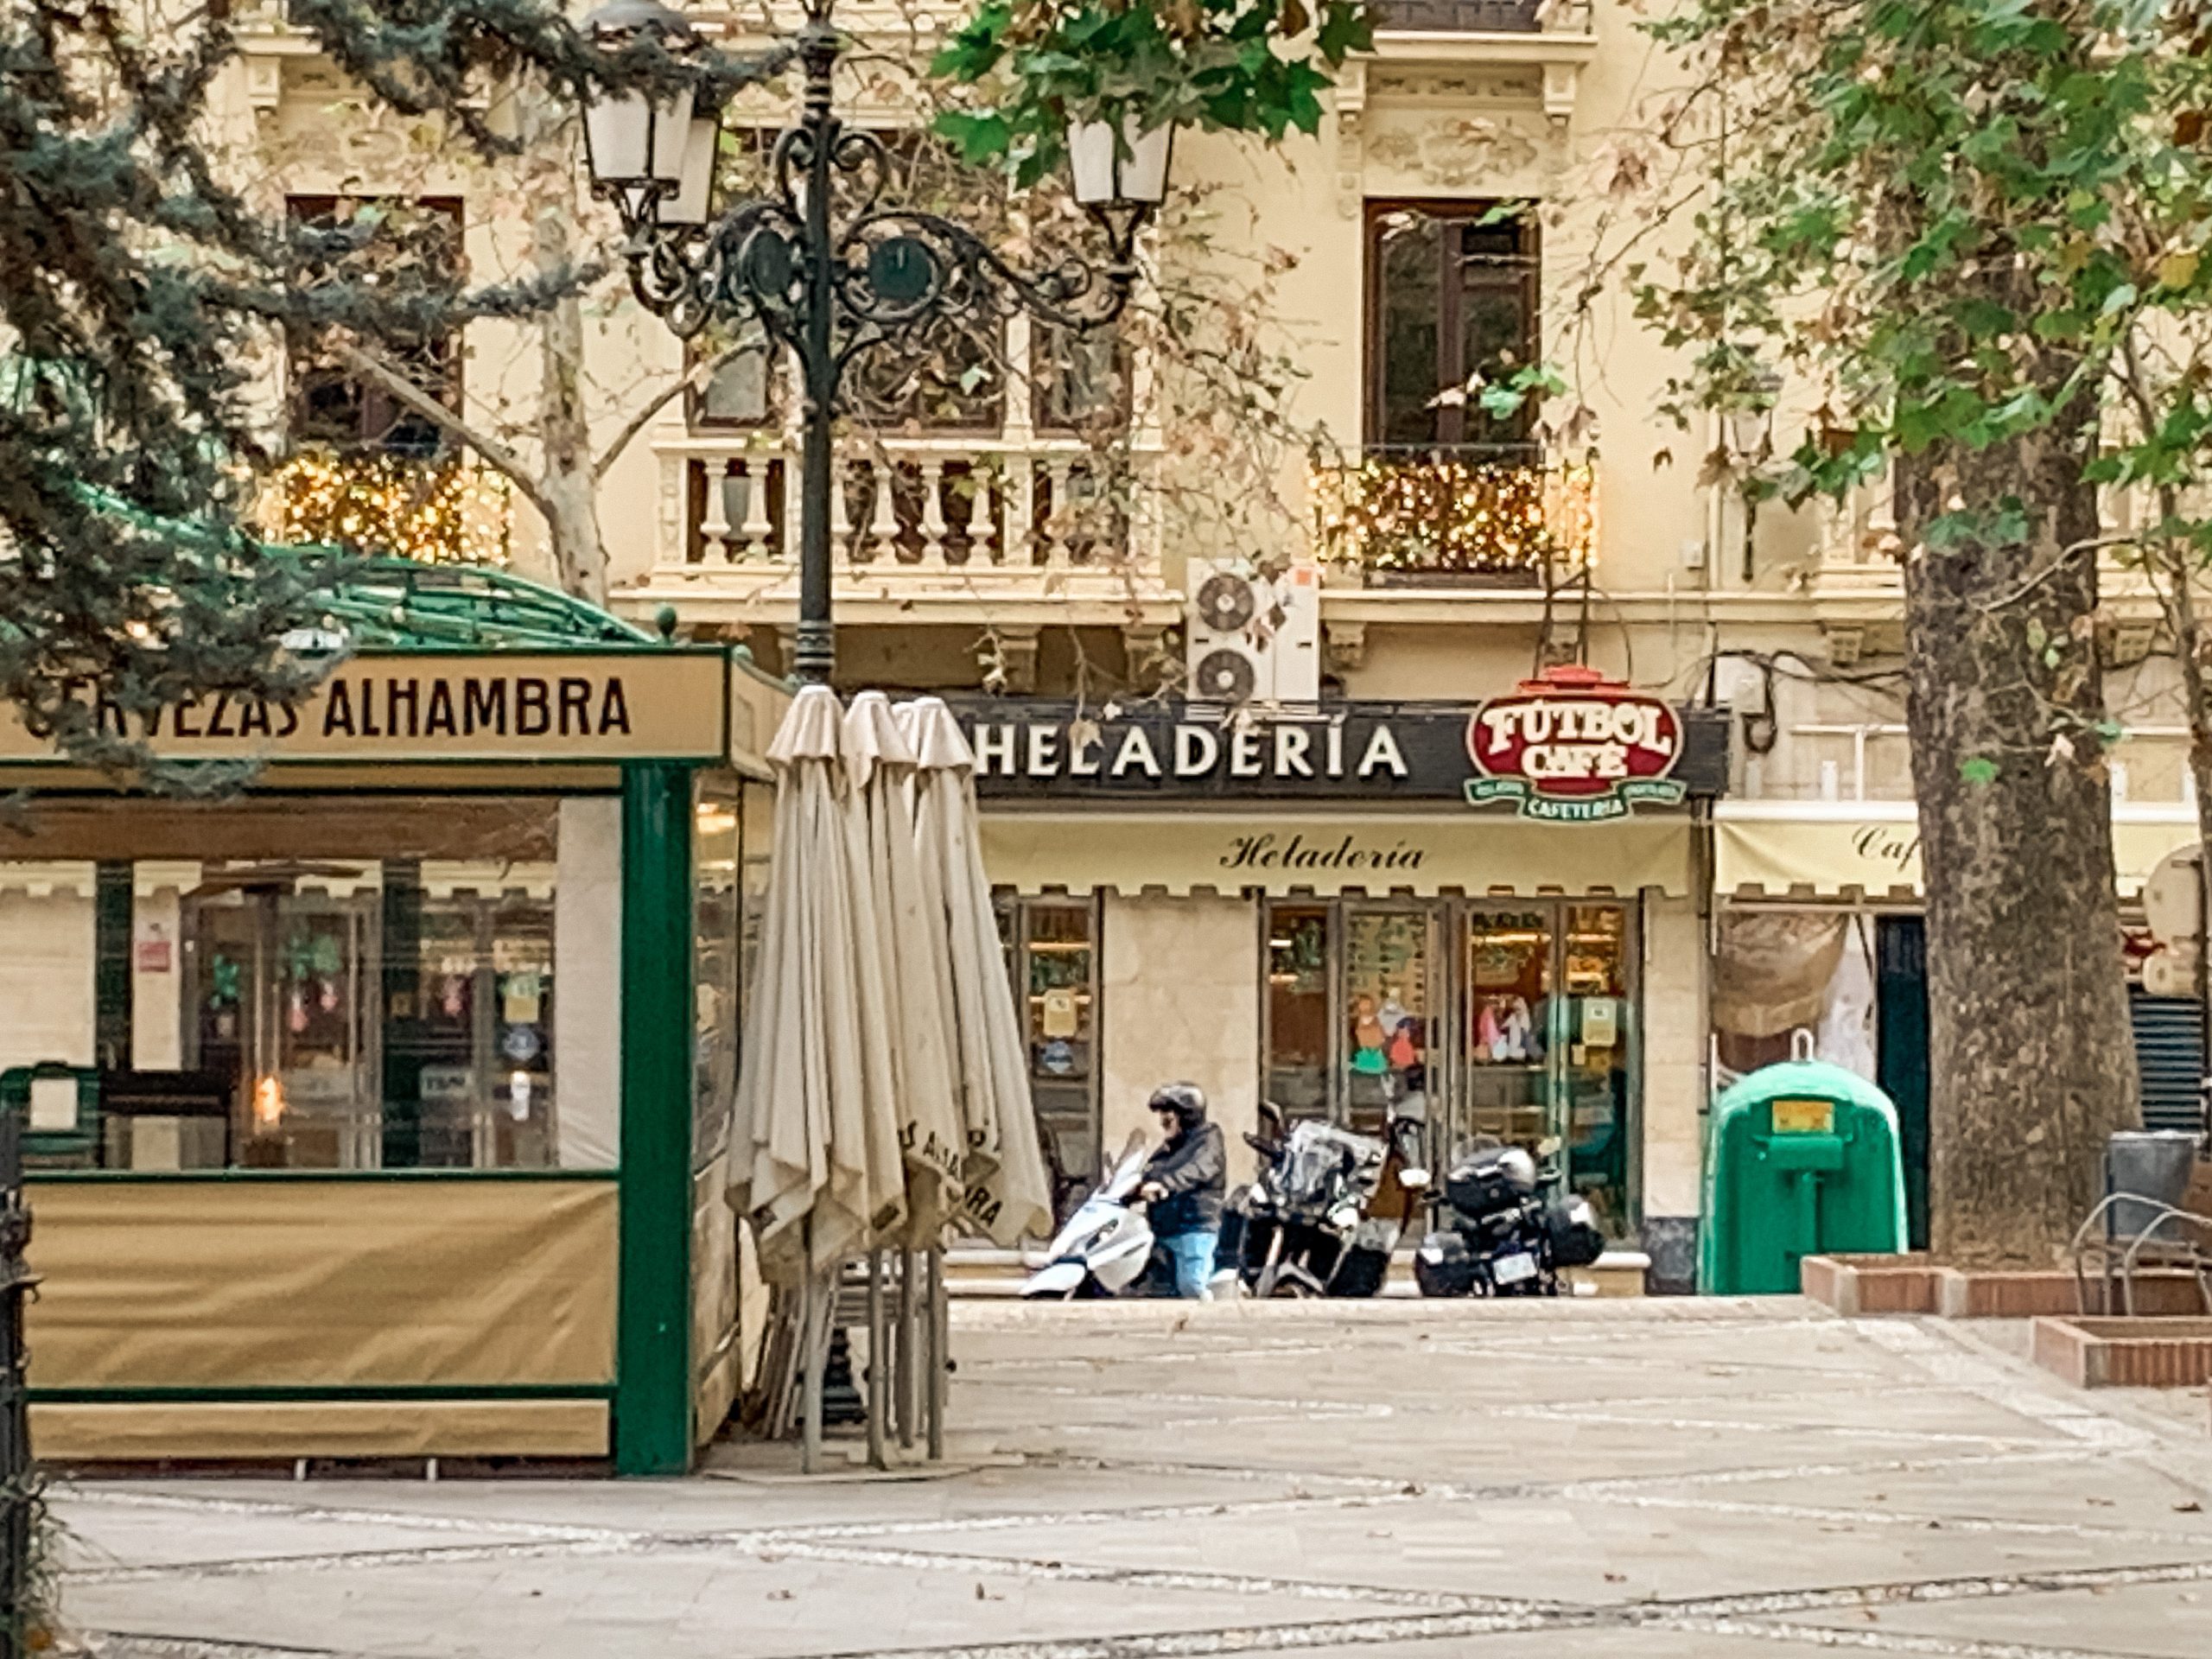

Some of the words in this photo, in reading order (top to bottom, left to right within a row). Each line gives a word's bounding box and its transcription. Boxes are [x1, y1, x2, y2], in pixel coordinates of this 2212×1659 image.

[322, 677, 632, 737] ALHAMBRA
[975, 714, 1408, 776] HELADERÍA
[1219, 833, 1425, 869] Heladería
